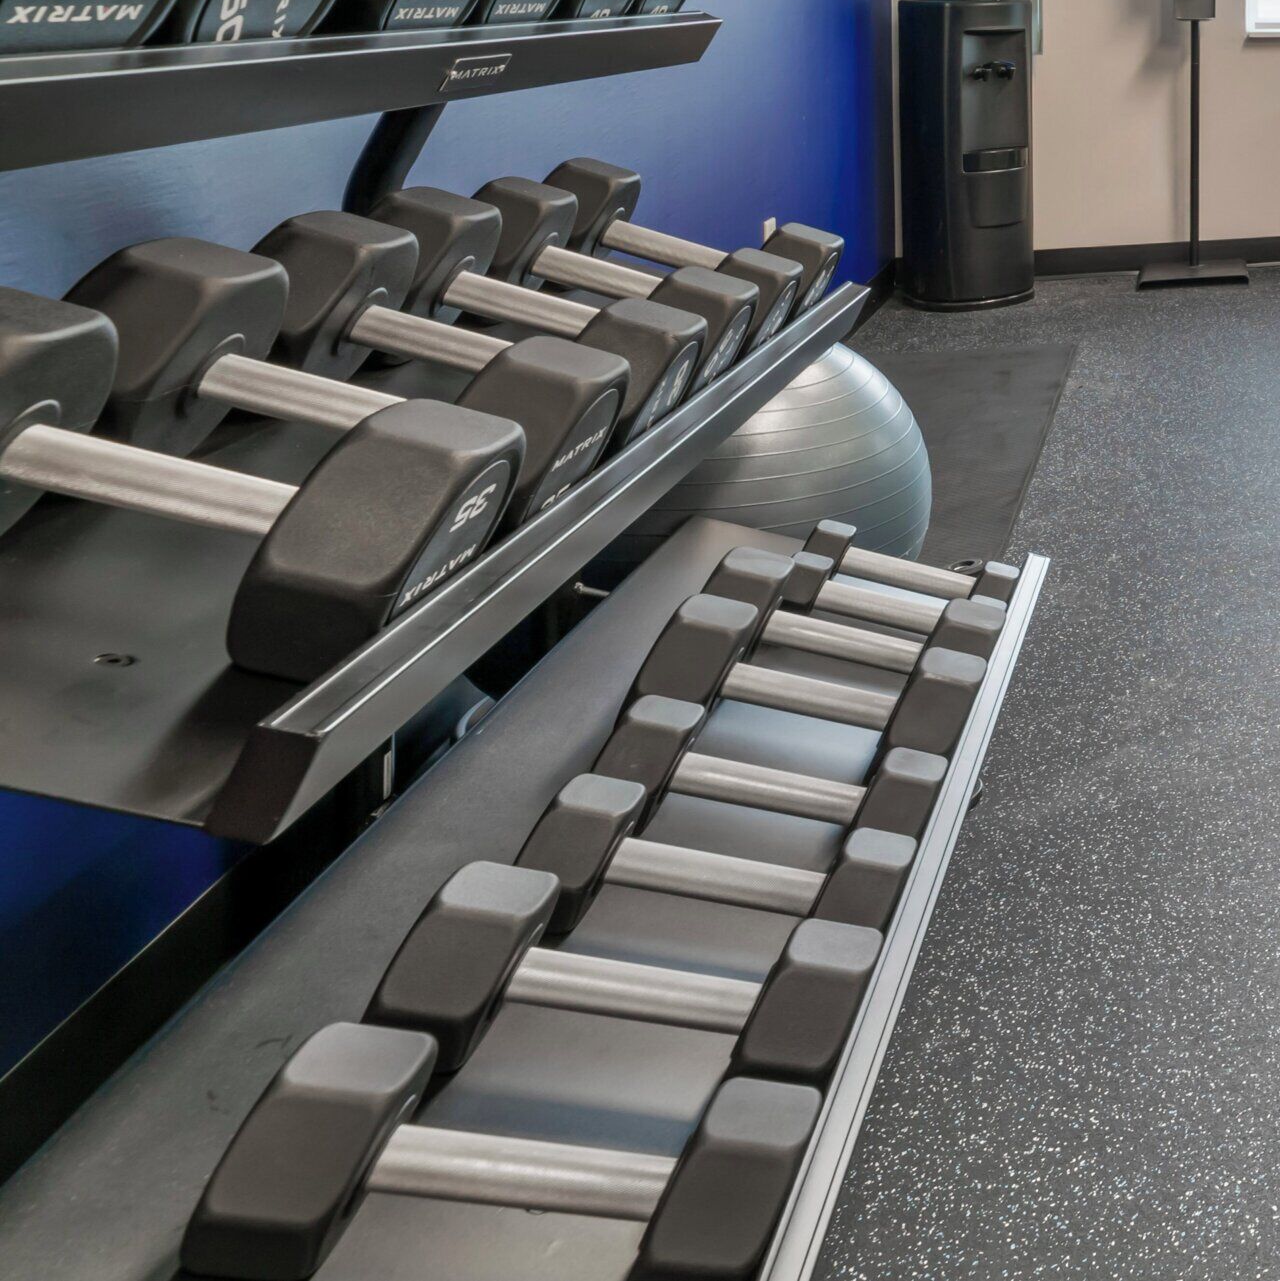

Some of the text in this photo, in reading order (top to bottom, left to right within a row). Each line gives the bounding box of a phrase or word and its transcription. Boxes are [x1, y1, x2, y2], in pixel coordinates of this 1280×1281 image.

[8, 4, 144, 24] MATRIX
[395, 5, 461, 20] MATRIX
[495, 2, 546, 16] MATRIX
[551, 426, 607, 472] MATRIX
[449, 483, 497, 533] 35
[399, 543, 477, 607] MATRIX
